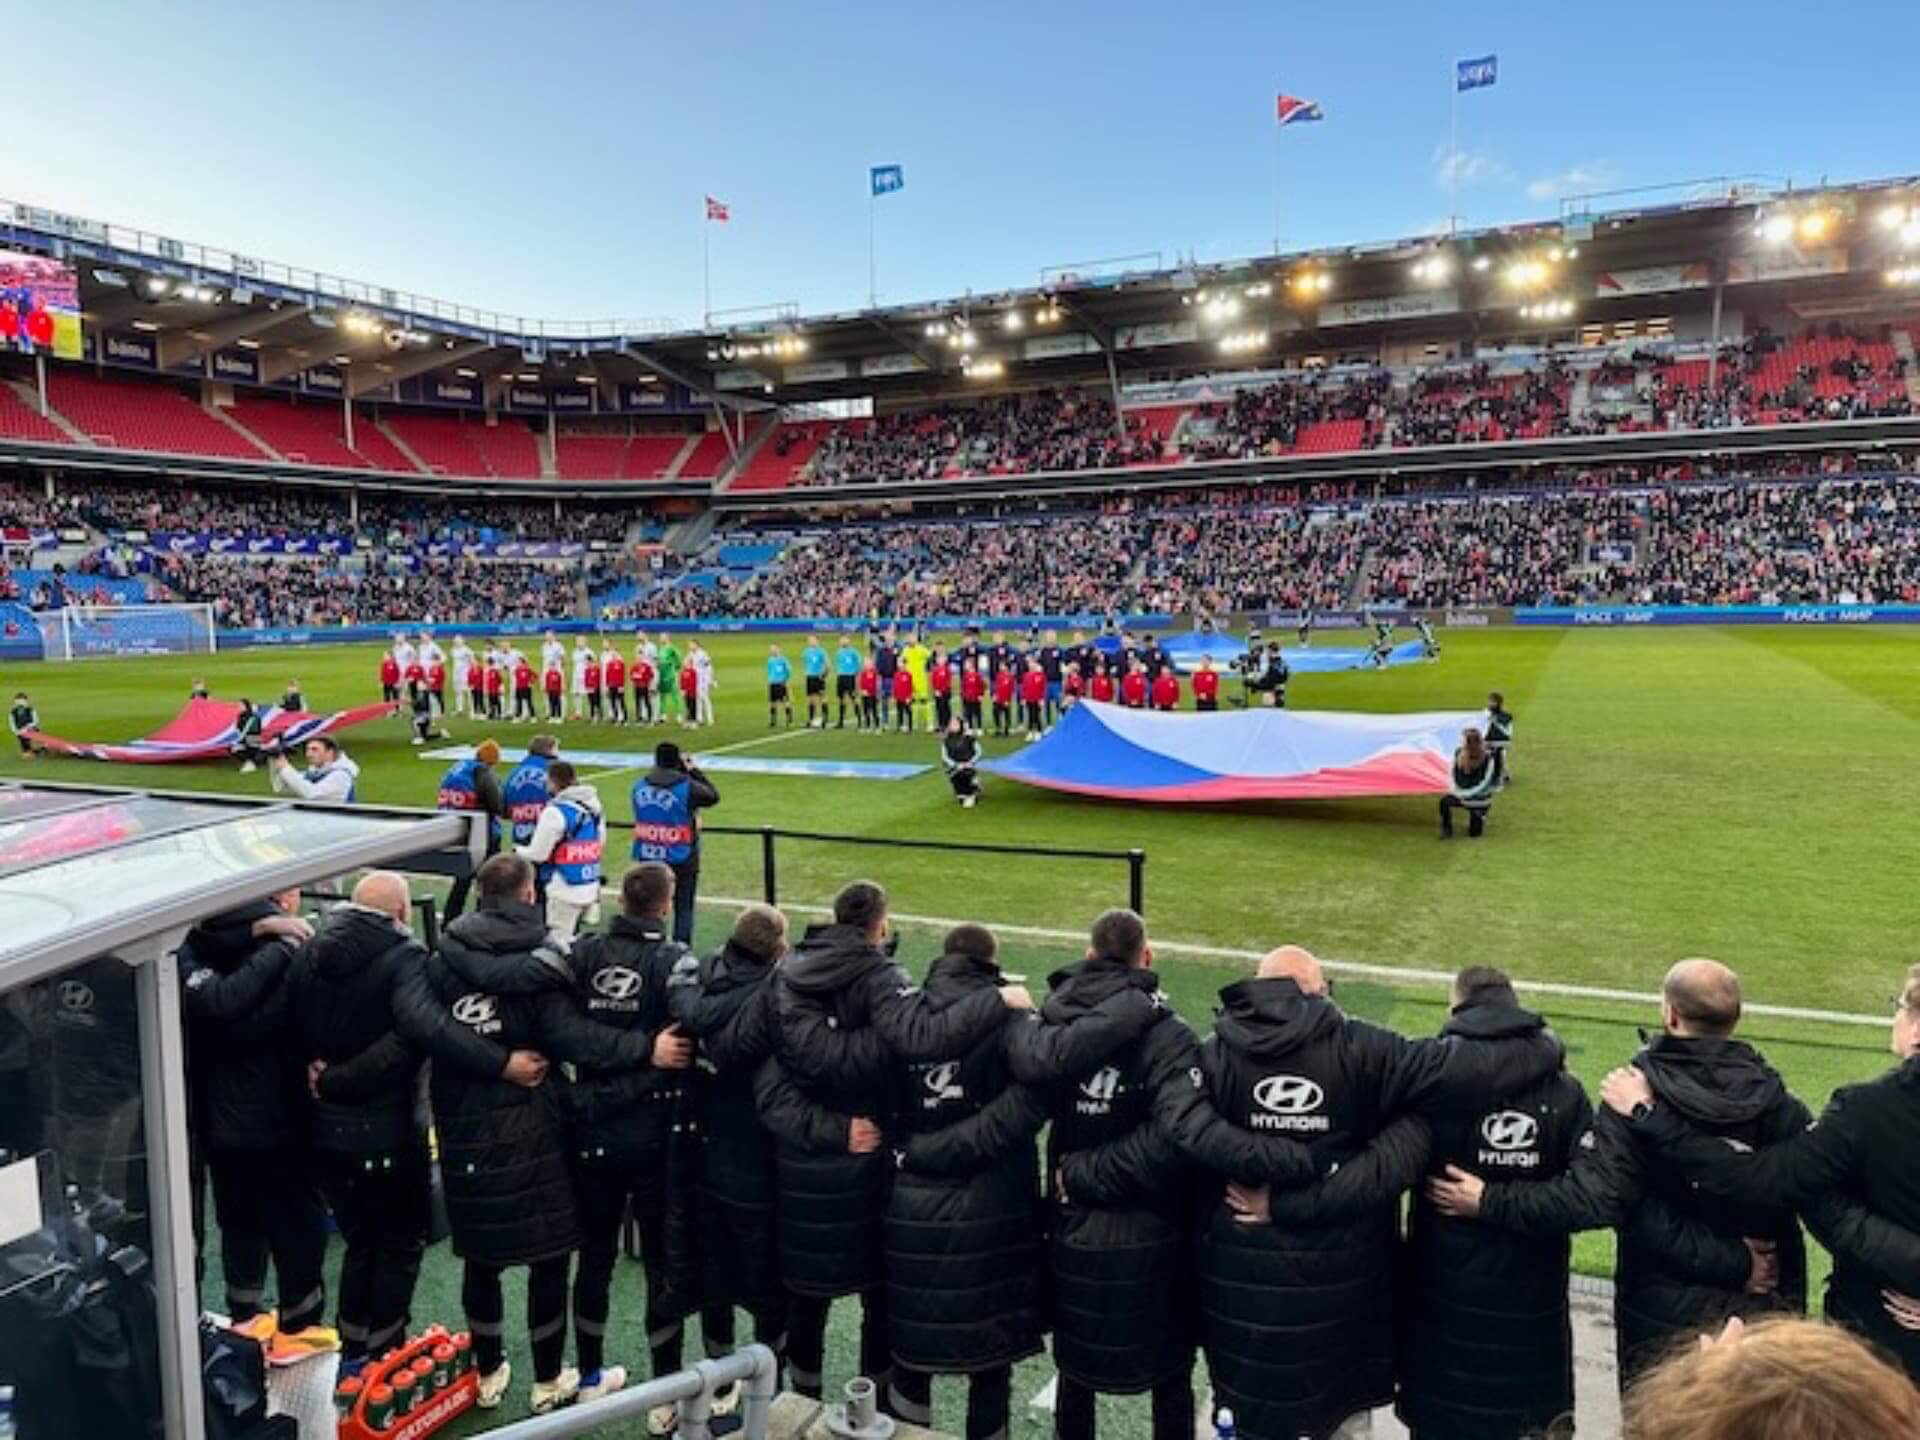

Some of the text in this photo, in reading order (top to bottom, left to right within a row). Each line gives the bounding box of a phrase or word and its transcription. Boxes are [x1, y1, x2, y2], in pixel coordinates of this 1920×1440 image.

[634, 823, 680, 842] HOTO
[567, 841, 601, 861] PHO
[1250, 1112, 1330, 1132] HYUNDAI
